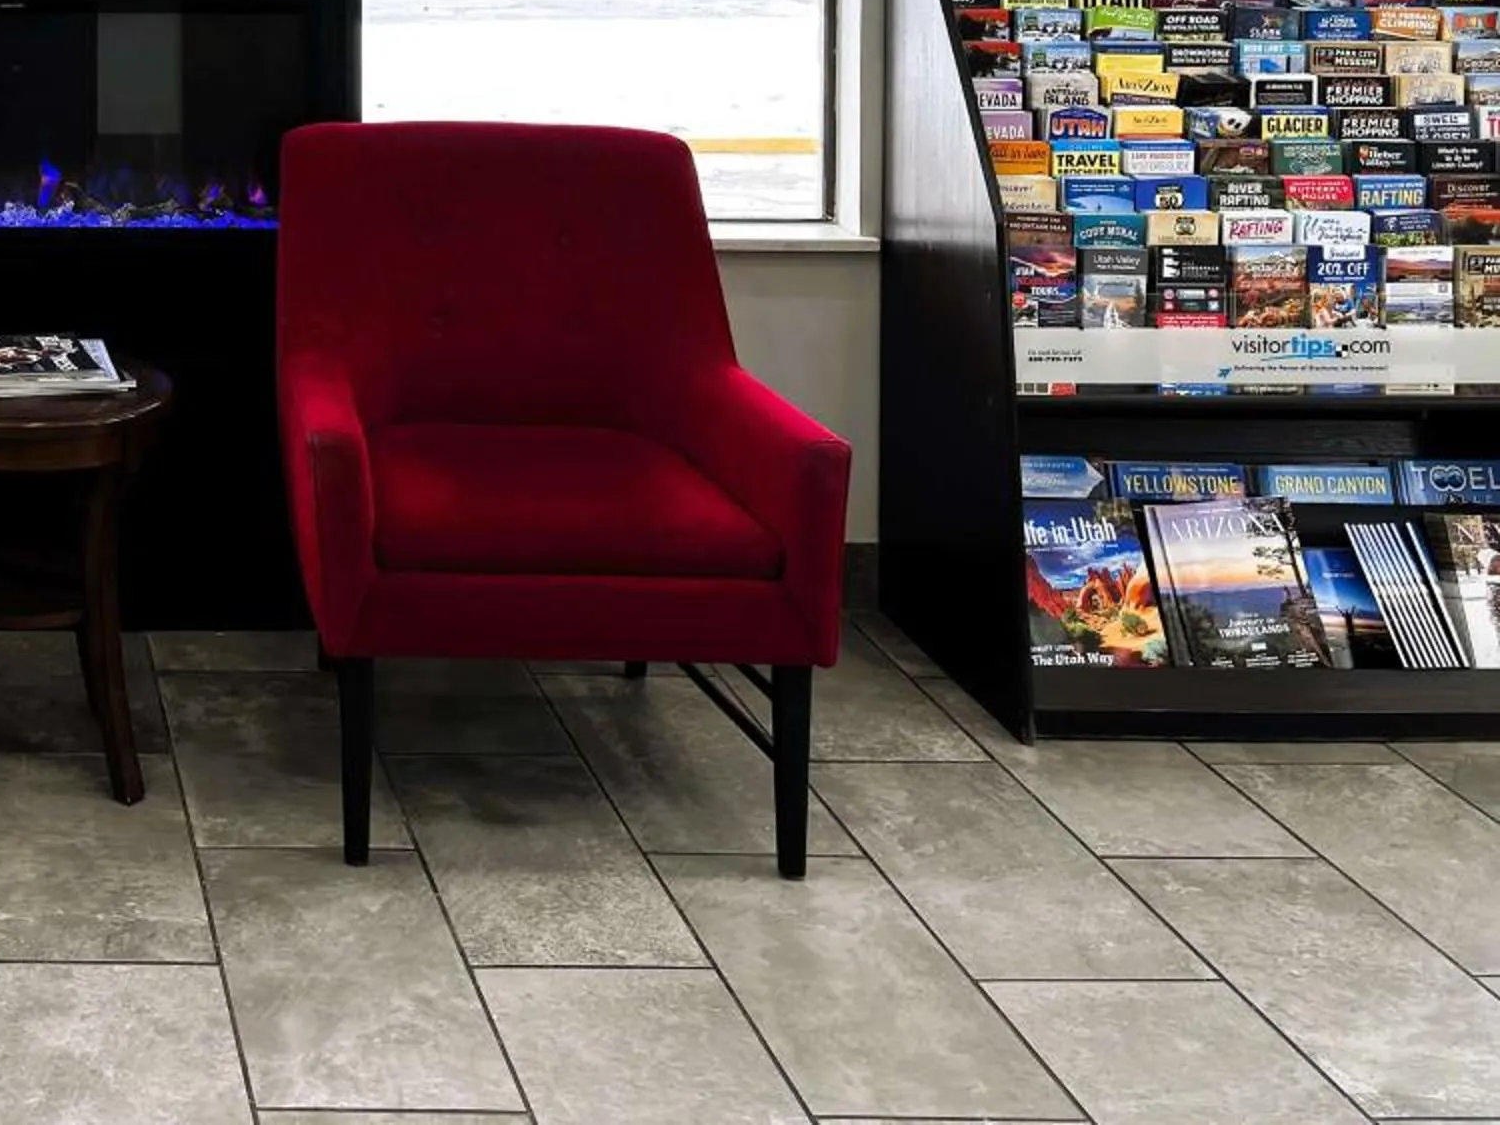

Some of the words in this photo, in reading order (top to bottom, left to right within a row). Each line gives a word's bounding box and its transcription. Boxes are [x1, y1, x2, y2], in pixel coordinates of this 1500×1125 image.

[1166, 15, 1186, 24] OFF
[1188, 15, 1219, 24] ROAD
[1335, 48, 1356, 56] PARK
[1358, 49, 1377, 57] CITY
[1334, 57, 1377, 66] MUSEUM
[1326, 85, 1383, 96] PREMIER
[1043, 96, 1090, 106] ISLAND
[1326, 95, 1384, 105] SHOPPING
[1051, 118, 1105, 137] UTAH
[1267, 116, 1323, 133] GLACIER
[1343, 118, 1399, 128] PREMIER
[1342, 128, 1400, 139] SHOPPING
[1057, 153, 1116, 168] TRAVEL
[1227, 183, 1263, 194] RIVER
[1289, 186, 1349, 194] BUTTERFLY
[1219, 194, 1270, 206] RAFTING
[1361, 190, 1424, 207] RAFTING
[1230, 222, 1284, 239] RAFTING
[1093, 254, 1113, 264] Utah
[1115, 254, 1141, 266] Valley
[1317, 262, 1344, 275] 20%
[1348, 262, 1371, 275] OFF
[1124, 475, 1241, 494] YELLOWSTONE
[1275, 475, 1325, 494] GRAND
[1326, 476, 1387, 495] CANYON
[1023, 520, 1048, 545] ife
[1050, 521, 1070, 544] in
[1071, 517, 1117, 542] Utah
[1170, 511, 1285, 542] ARIZONA
[1031, 654, 1053, 666] The
[1055, 653, 1085, 665] Utah
[1088, 653, 1115, 667] Way
